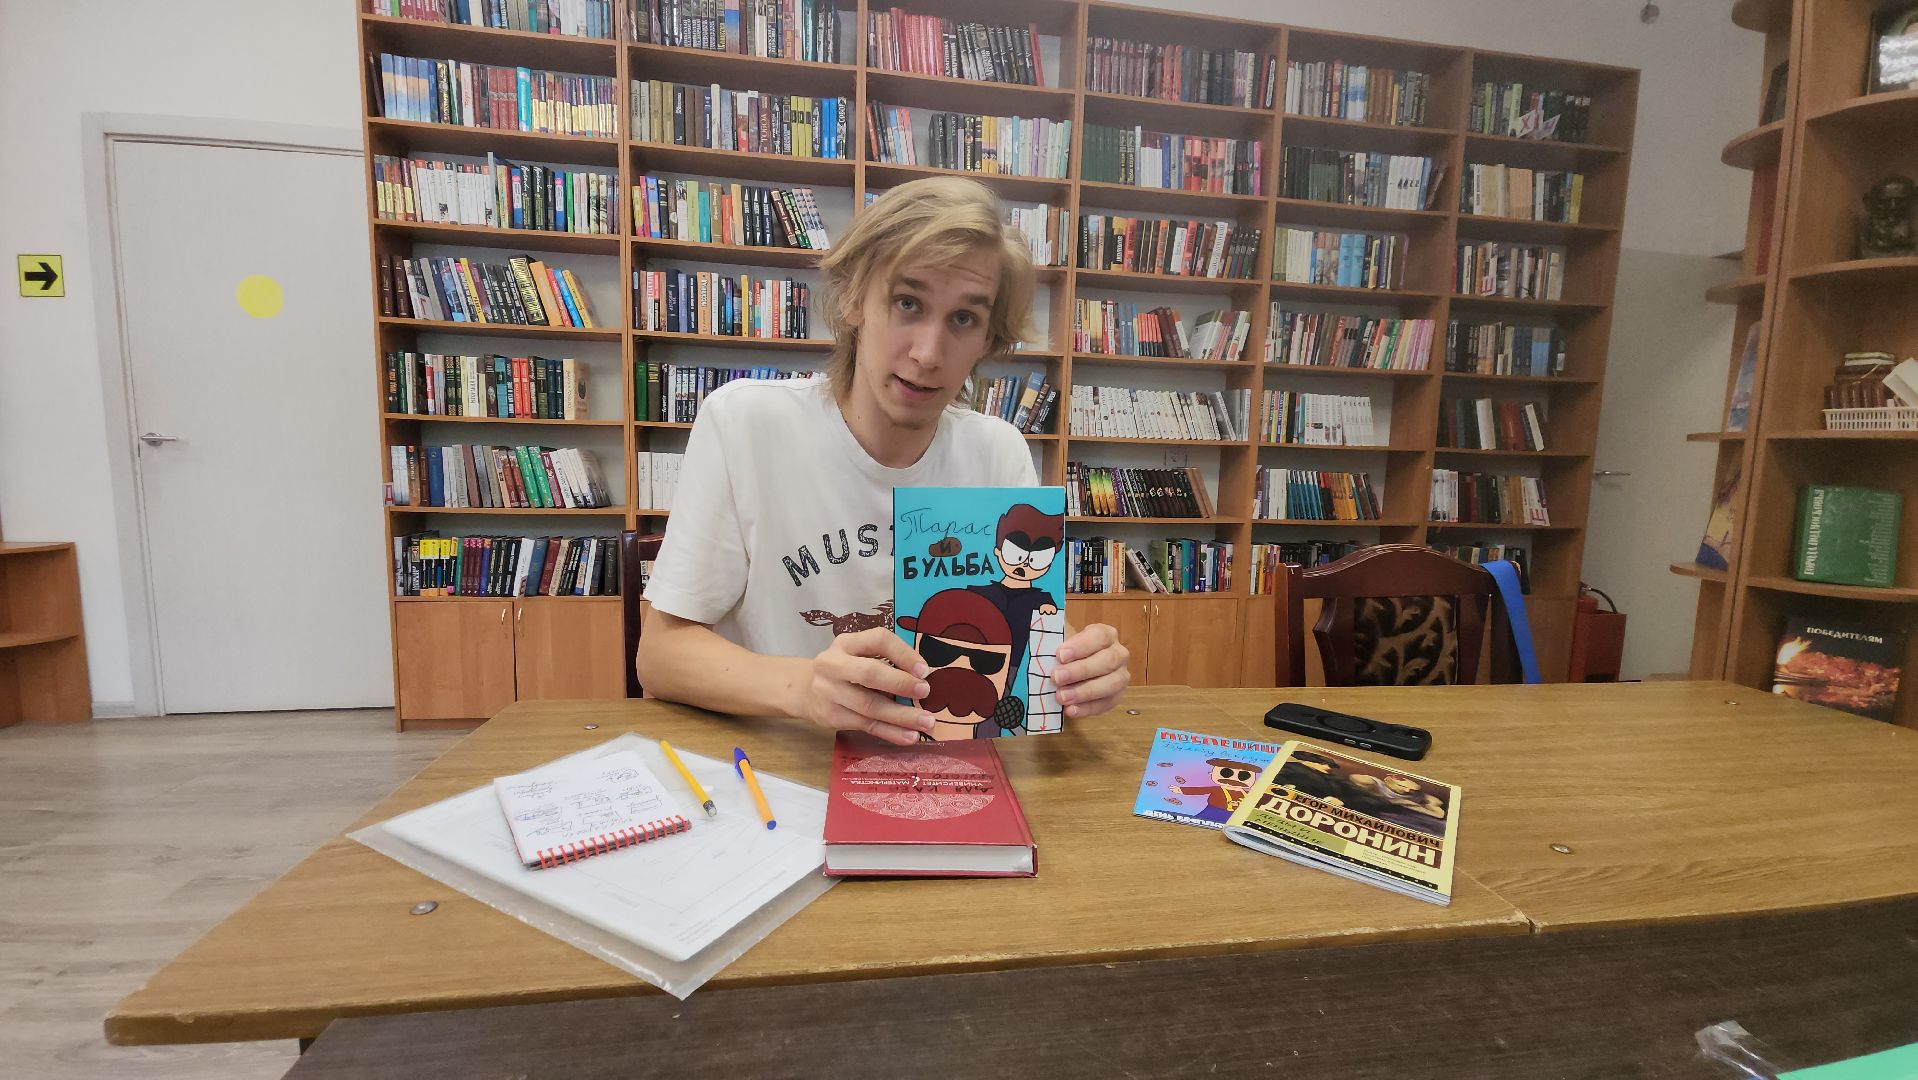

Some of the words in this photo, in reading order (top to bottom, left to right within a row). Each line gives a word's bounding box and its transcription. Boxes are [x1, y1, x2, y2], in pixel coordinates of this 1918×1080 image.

[900, 504, 992, 541] Тарас
[902, 551, 995, 580] БУЛЬБА
[1806, 626, 1883, 644] ПОБЕДИТЕЛЯМ
[1259, 796, 1436, 866] ДОРОНИН
[1295, 793, 1328, 811] ЕГОР
[1331, 807, 1441, 848] МИХАЙЛОВИЧ
